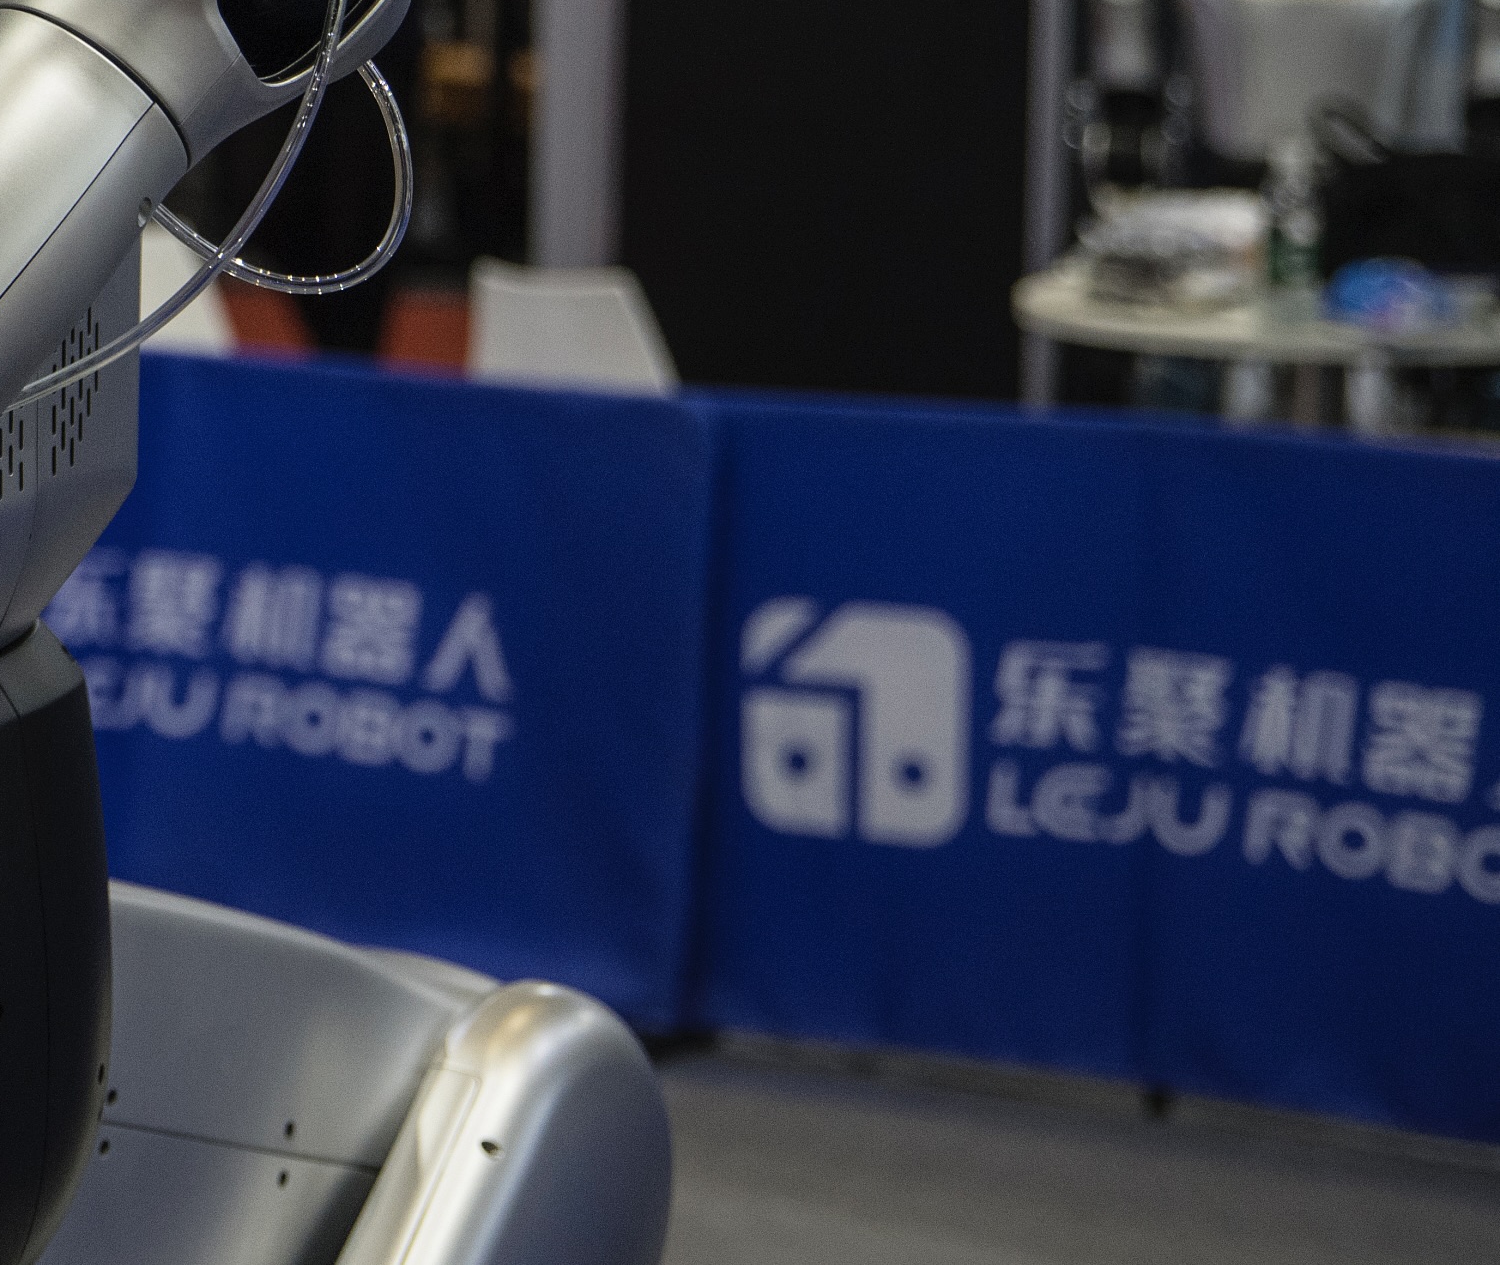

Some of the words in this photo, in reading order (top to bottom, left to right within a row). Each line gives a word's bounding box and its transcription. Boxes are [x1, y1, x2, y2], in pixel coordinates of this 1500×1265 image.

[219, 670, 514, 784] ROBOT
[988, 638, 1500, 812] 乐聚机器
[986, 758, 1232, 856] LEJU
